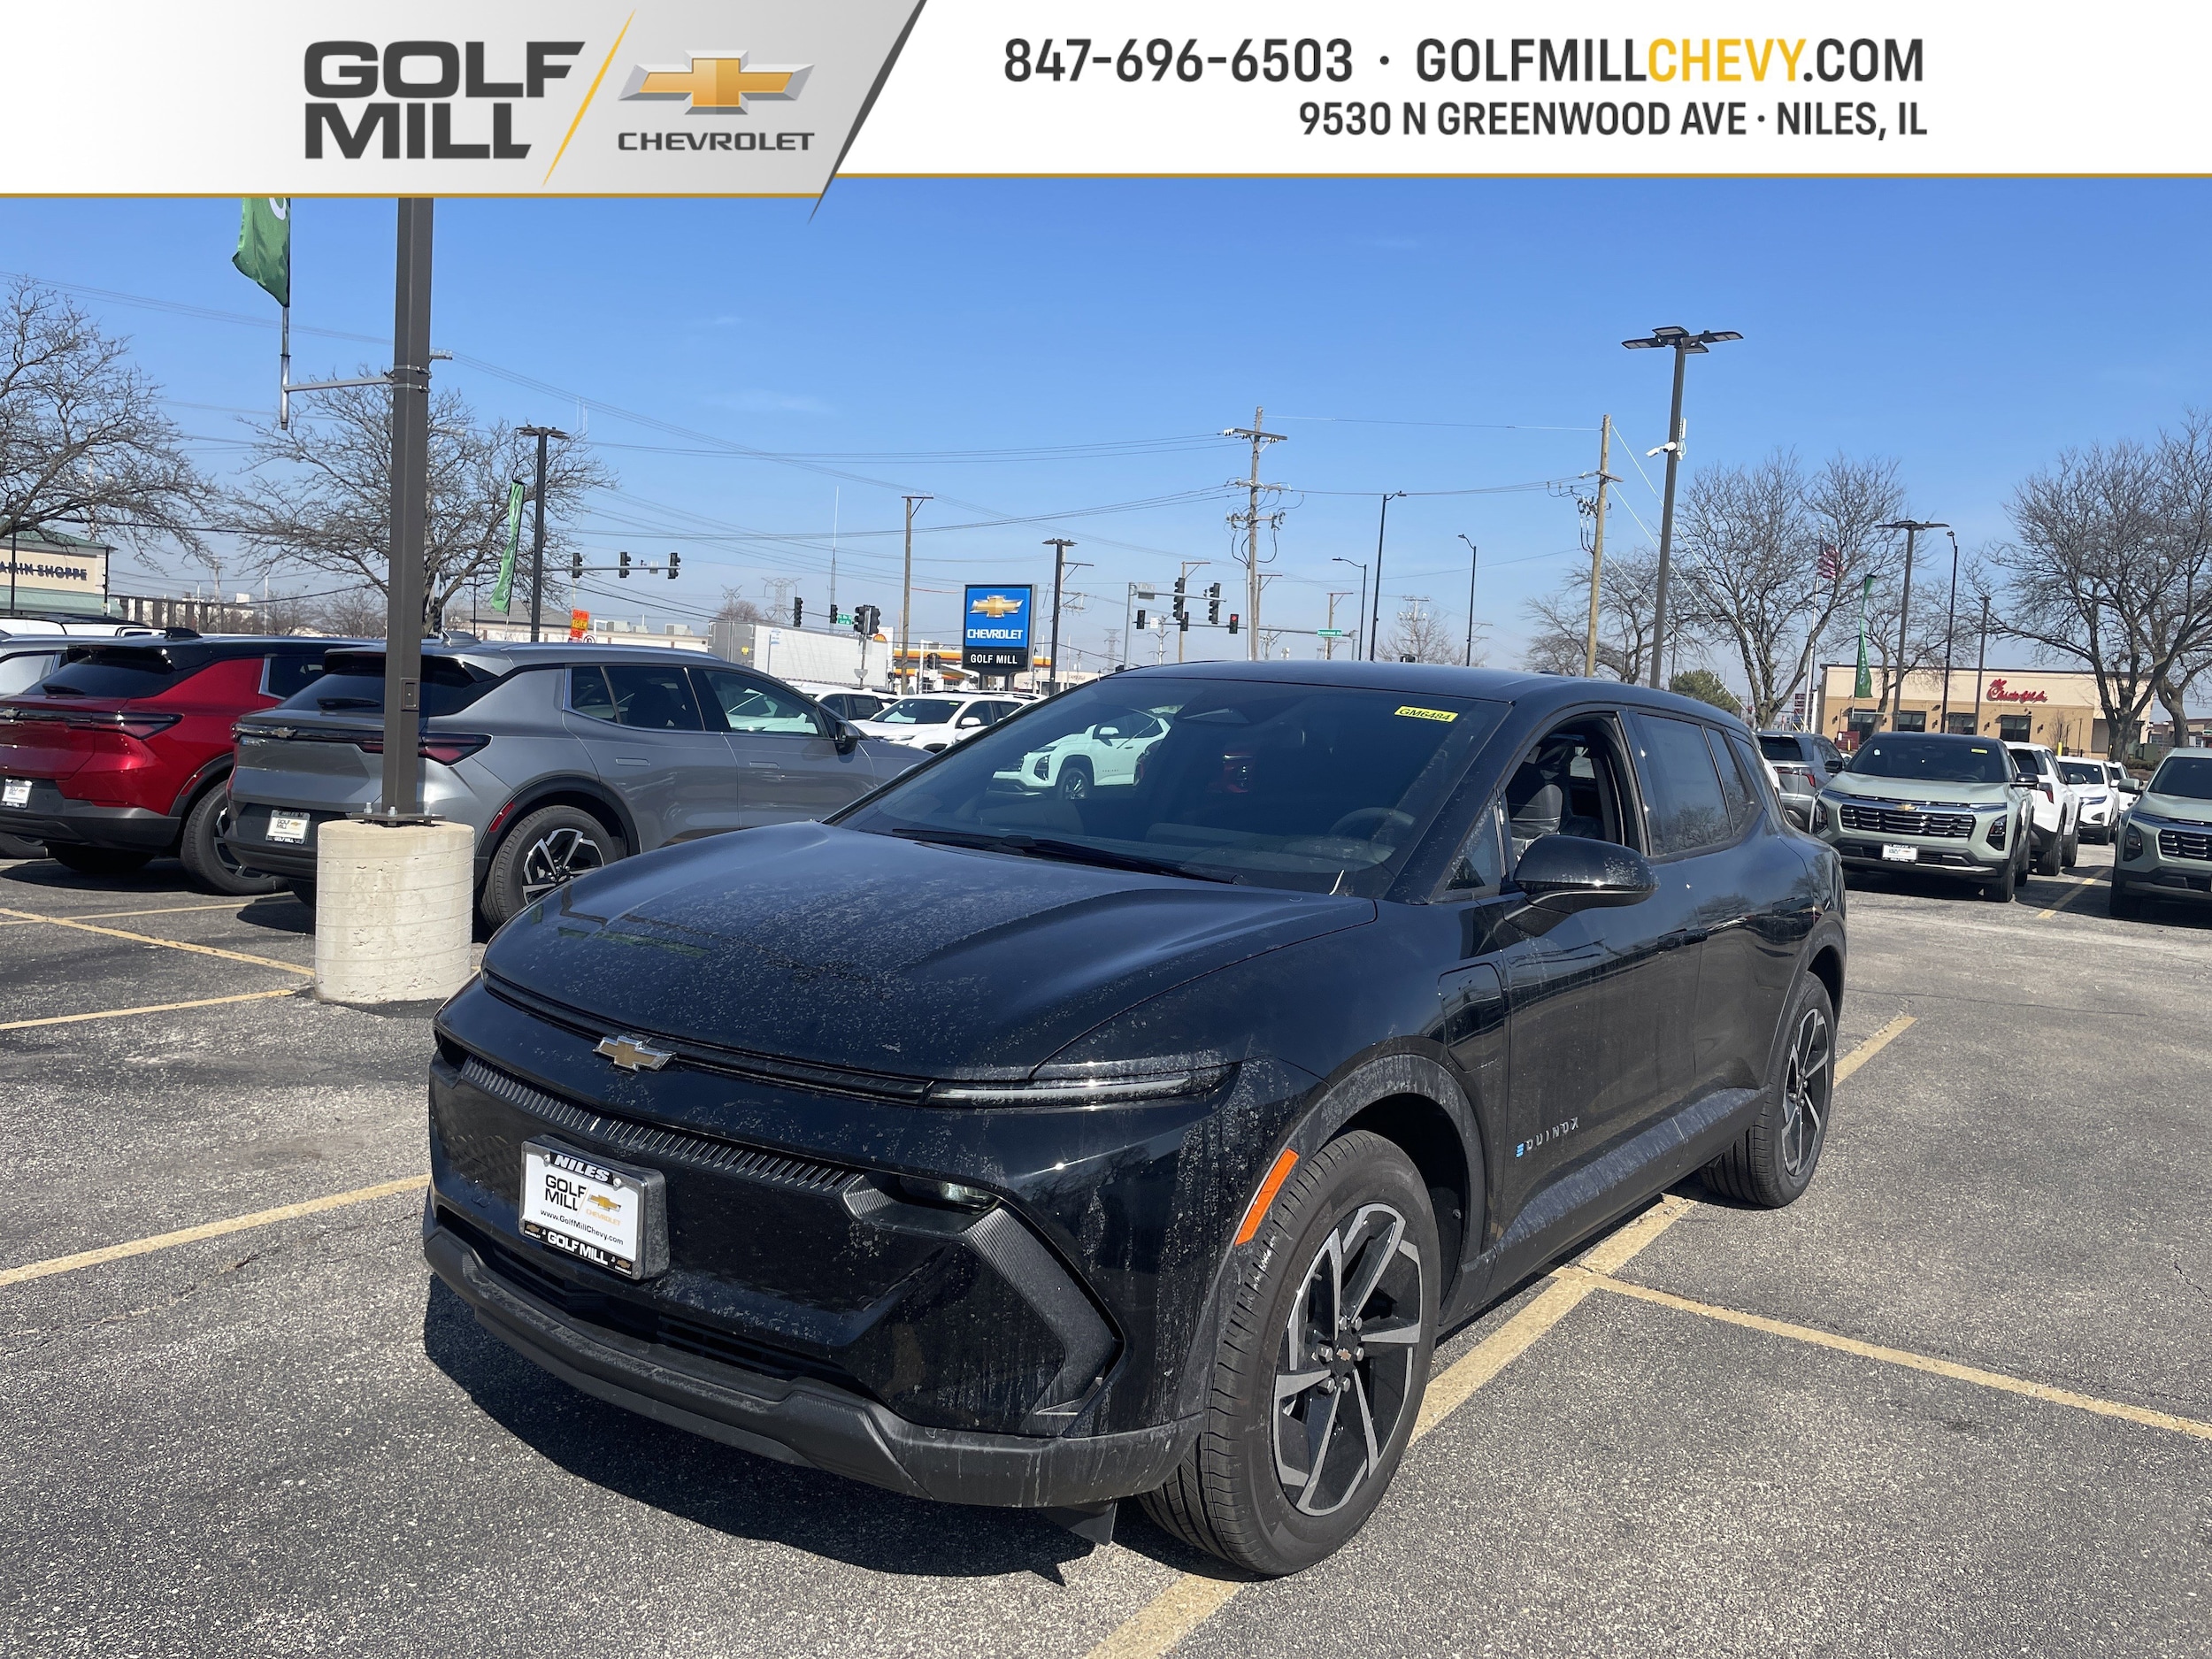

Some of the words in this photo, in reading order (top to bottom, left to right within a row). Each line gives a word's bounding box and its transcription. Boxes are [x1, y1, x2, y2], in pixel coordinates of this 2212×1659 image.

[37, 565, 88, 580] SHOPPE
[967, 628, 1024, 640] CHEVROLET
[970, 654, 994, 664] GOLF
[995, 655, 1018, 664] MILL
[1399, 708, 1452, 720] GM6484
[554, 1154, 611, 1182] NILES
[545, 1174, 587, 1199] GOLF
[545, 1188, 579, 1211] MILL
[540, 1210, 624, 1245] www.GolfMillChevy.com
[586, 1209, 621, 1226] CHEVROLET
[547, 1231, 579, 1253] GOLF
[579, 1243, 609, 1265] MILL
